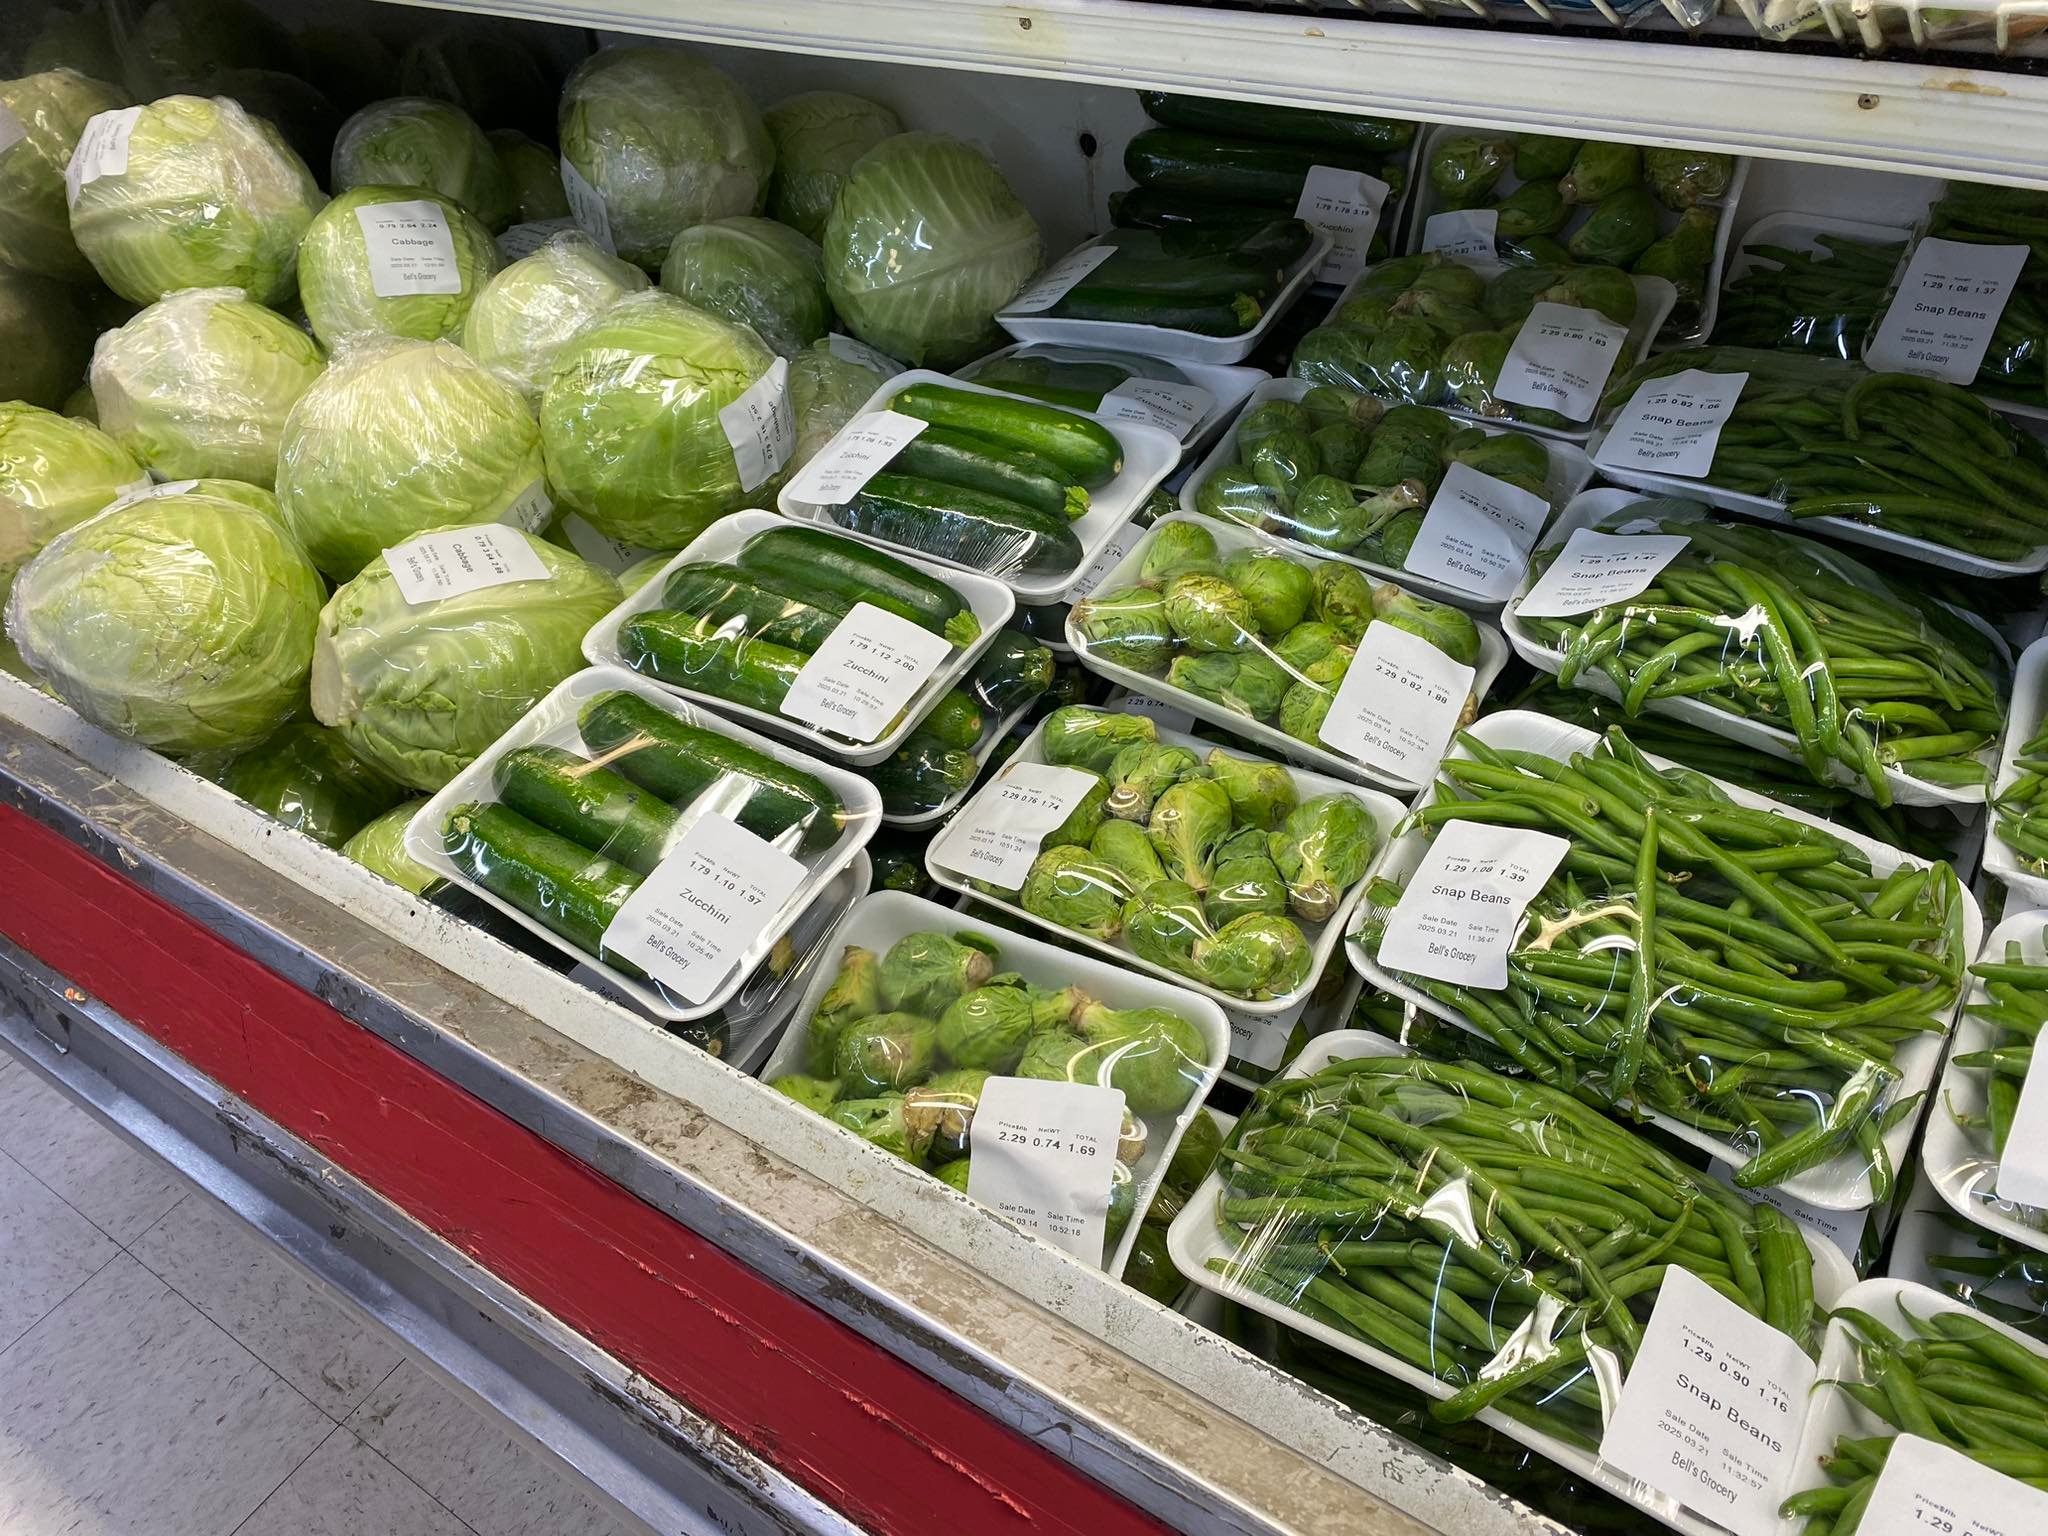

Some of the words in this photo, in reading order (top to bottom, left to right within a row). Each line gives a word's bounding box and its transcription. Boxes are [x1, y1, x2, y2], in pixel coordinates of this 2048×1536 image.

[391, 238, 434, 247] Cabbage
[1921, 280, 1943, 290] 1.29
[1948, 284, 1969, 293] 1.06
[1974, 287, 1997, 295] 1.37
[1914, 302, 1945, 316] Snap
[1949, 306, 1987, 320] Beans
[1540, 328, 1560, 336] 2.29
[1942, 332, 1957, 341] Sale
[1907, 349, 1925, 361] Bell's
[1925, 351, 1950, 366] Grocery
[1531, 381, 1547, 392] Bell's
[1547, 384, 1569, 400] Grocery
[1671, 398, 1694, 409] 0.82
[768, 400, 781, 442] Cabbage
[1641, 413, 1673, 425] Snap
[1675, 418, 1714, 427] Beans
[839, 451, 871, 461] Zucchini
[1637, 448, 1655, 458] Bell's
[452, 543, 474, 573] Cabbage
[1445, 535, 1459, 544] Sale
[1459, 539, 1474, 549] Date
[1482, 549, 1495, 558] Sale
[1495, 553, 1511, 564] Time
[1606, 556, 1628, 564] 1.14
[1446, 557, 1464, 571] Bell's
[1463, 563, 1488, 581] Grocery
[1571, 571, 1604, 580] Snap
[1607, 567, 1648, 578] Beans
[849, 639, 869, 651] 1.79
[871, 648, 892, 661] 1.12
[894, 658, 915, 672] 2.00
[842, 659, 891, 685] Zucchini
[823, 675, 838, 685] Sale
[855, 688, 871, 699] Sale
[870, 694, 885, 707] Time
[1375, 664, 1397, 680] 2.29
[1400, 676, 1422, 693] 0.82
[1426, 689, 1448, 705] 1.88
[820, 697, 837, 712] Bell's
[836, 703, 858, 720] Grocery
[1146, 700, 1165, 708] 0.74
[1362, 707, 1377, 718] Sale
[1376, 714, 1392, 726] Date
[1399, 727, 1414, 738] Sale
[1415, 734, 1430, 746] Time
[1363, 731, 1382, 748] Bell's
[1381, 740, 1407, 761] Grocery
[1001, 790, 1020, 801] 2.29
[1020, 794, 1038, 805] 0.76
[1041, 800, 1060, 812] 1.74
[1001, 833, 1014, 841] Sale
[1013, 837, 1027, 845] Time
[969, 847, 984, 860] Bell's
[983, 851, 1004, 867] Grocery
[1442, 863, 1468, 874] 1.29
[1471, 865, 1494, 874] 1.08
[1498, 868, 1526, 883] 1.39
[1509, 863, 1530, 875] TOTAL
[689, 859, 711, 876] 1.79
[713, 873, 736, 892] 1.10
[738, 889, 763, 907] 1.97
[749, 883, 768, 899] TOTAL
[679, 887, 732, 925] Zucchini
[1431, 885, 1467, 901] Snap
[1470, 889, 1512, 905] Beans
[645, 913, 681, 938] 2025.03.21
[653, 907, 670, 920] Sale
[669, 915, 685, 929] Date
[690, 929, 707, 943] Sale
[706, 938, 723, 953] Time
[1417, 923, 1458, 938] 2025.03.21
[1422, 913, 1439, 923] Sale
[1440, 917, 1458, 928] Date
[1467, 922, 1484, 933] Sale
[1484, 926, 1500, 935] Time
[646, 934, 667, 953] Bell's
[664, 945, 692, 971] Grocery
[1428, 942, 1450, 959] Bell's
[1450, 947, 1478, 966] Grocery
[1229, 1021, 1254, 1041] Grocery
[998, 1131, 1027, 1145] 2.29
[1032, 1137, 1061, 1151] 0.74
[1068, 1143, 1097, 1157] 1.69
[1037, 1127, 1062, 1135] NetWT
[1075, 1133, 1099, 1144] TOTAL
[998, 1202, 1017, 1213] Sale
[1017, 1205, 1036, 1216] Date
[1047, 1211, 1065, 1223] Sale
[1066, 1215, 1086, 1225] Time
[1762, 1193, 1783, 1208] Date
[1793, 1208, 1815, 1223] Sale
[1816, 1217, 1839, 1233] Time
[1682, 1337, 1713, 1363] 1.29
[1719, 1361, 1751, 1388] 0.90
[1758, 1387, 1788, 1414] 1.16
[1725, 1351, 1751, 1371] NetWT
[1767, 1379, 1792, 1401] TOTAL
[1676, 1373, 1722, 1412] Snap
[1726, 1406, 1783, 1454] Beans
[1656, 1419, 1710, 1457] 2025.03.21
[1721, 1462, 1763, 1492] 11:32:57
[1665, 1408, 1687, 1427] Sale
[1688, 1425, 1711, 1443] Date
[1722, 1447, 1744, 1467] Sale
[1745, 1463, 1769, 1483] Time
[1671, 1451, 1699, 1479] Bell's
[1700, 1469, 1738, 1504] Grocery
[1914, 1508, 1954, 1534] 1.29
